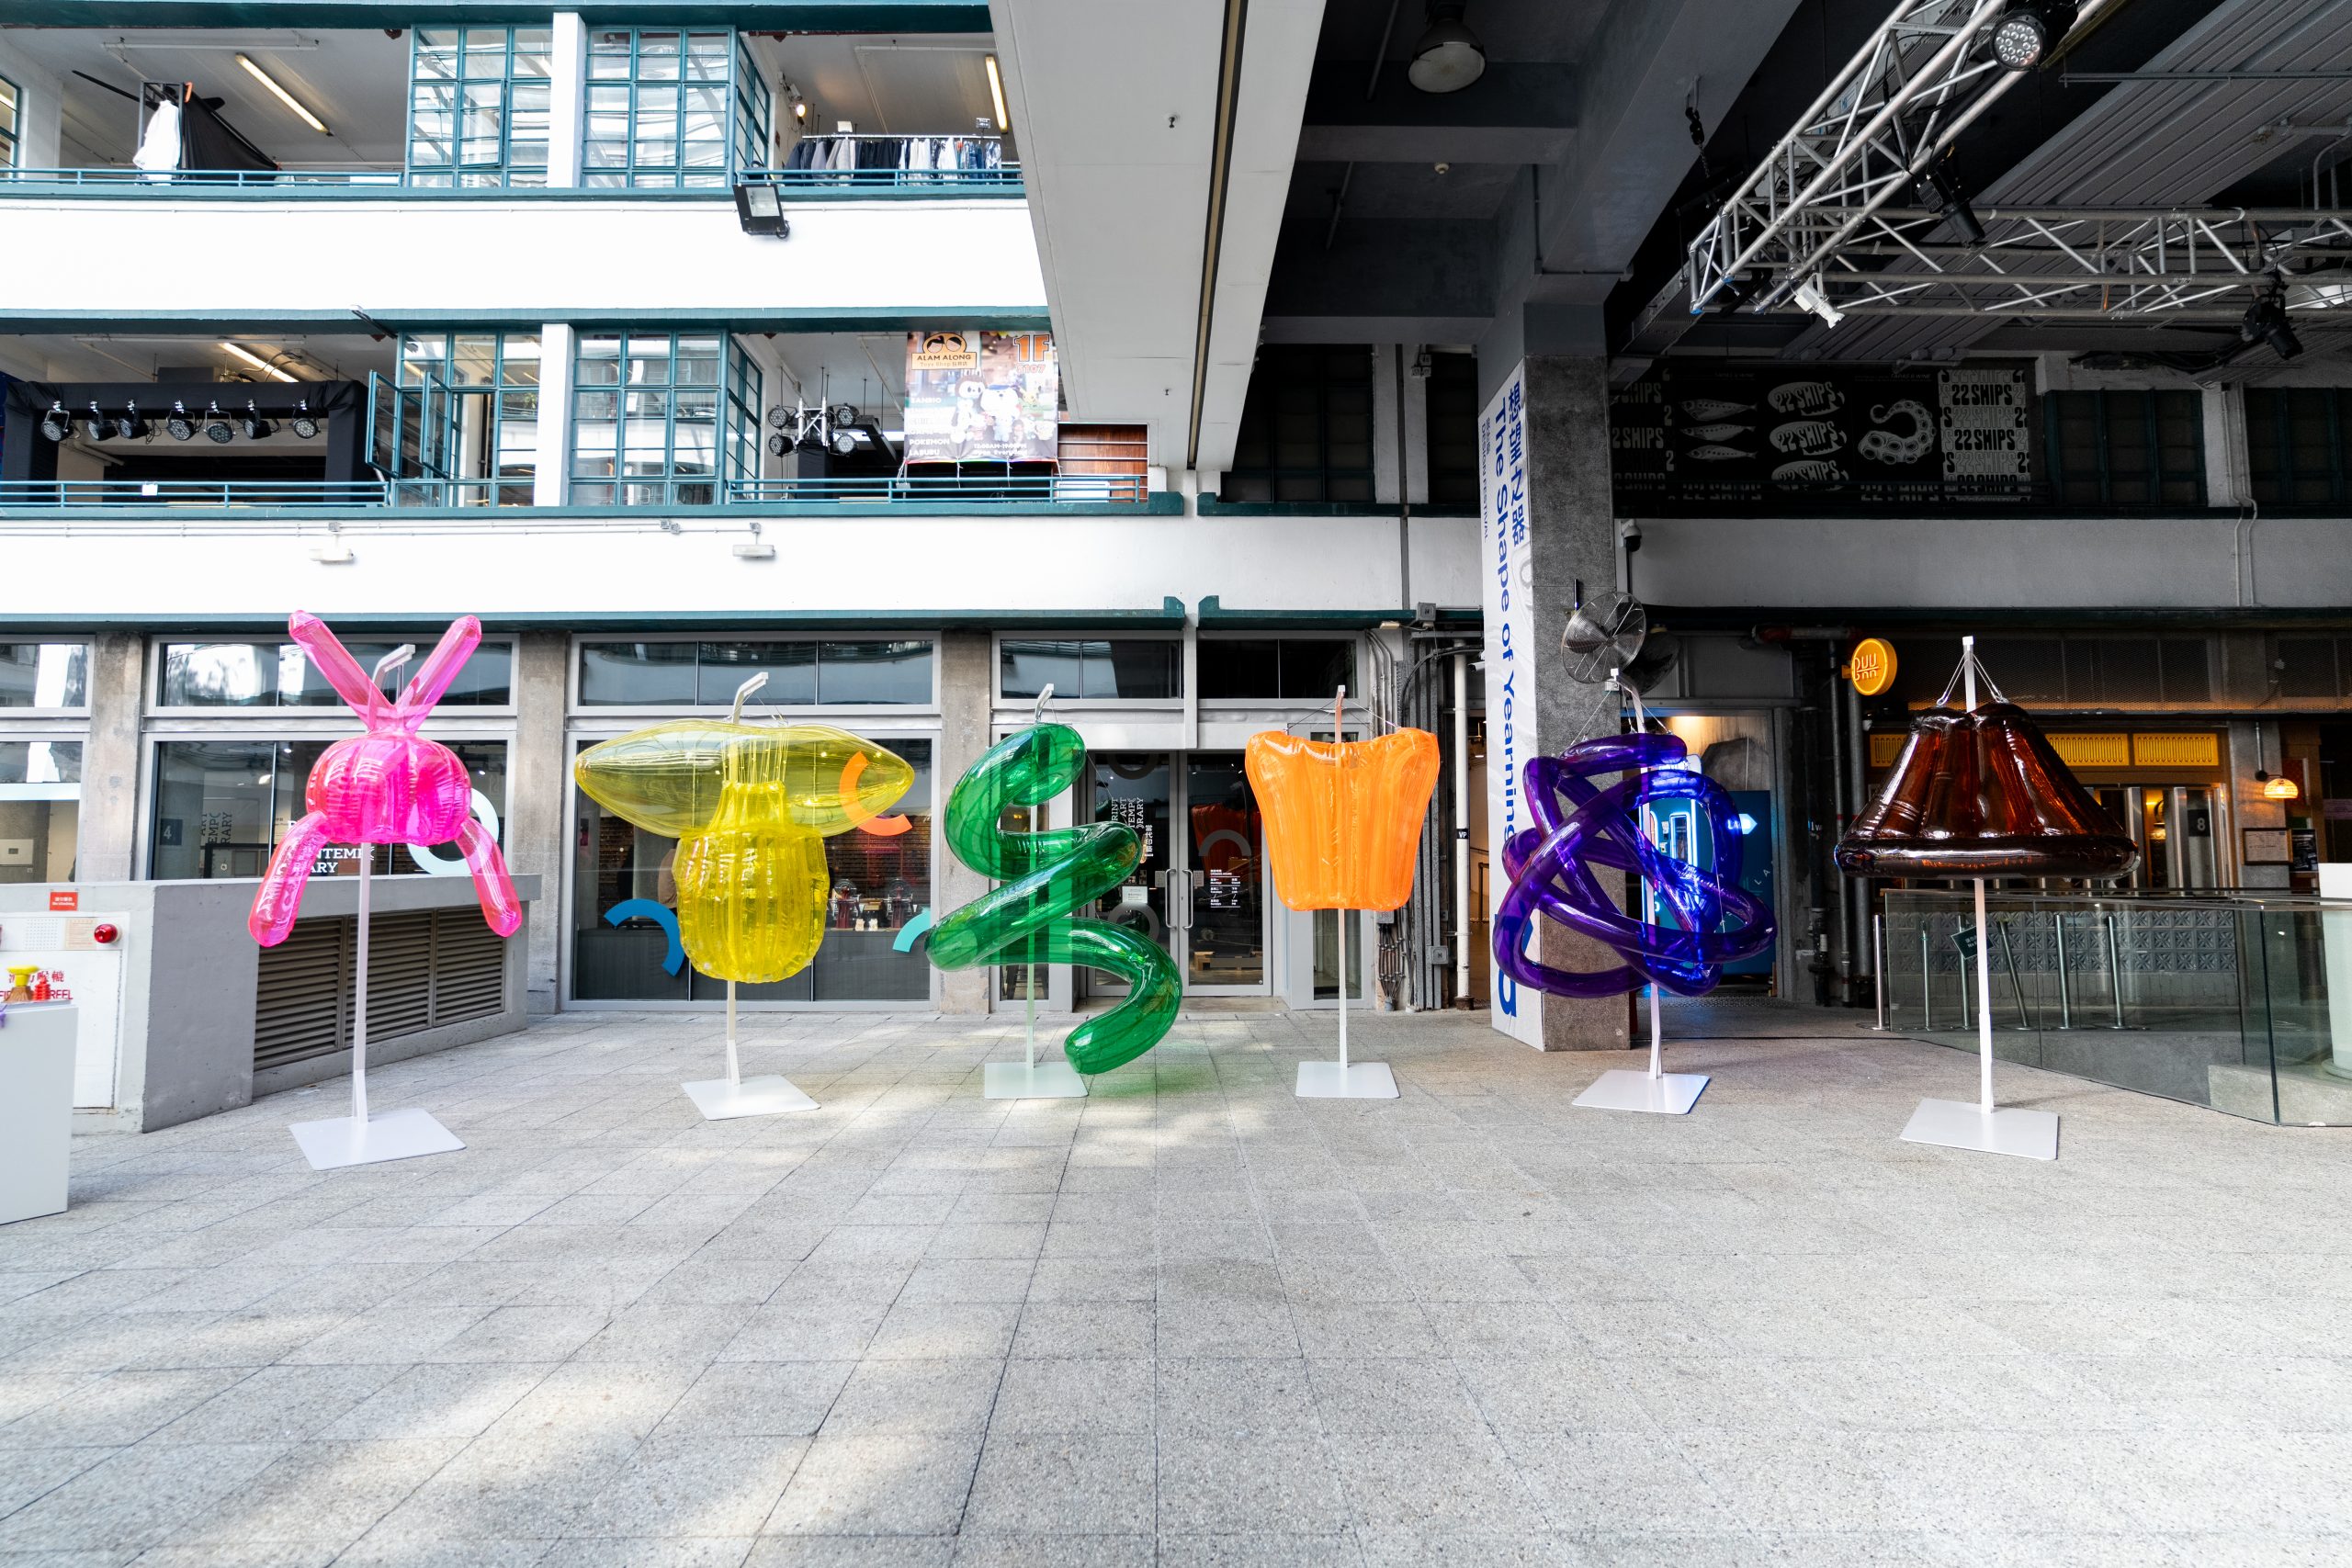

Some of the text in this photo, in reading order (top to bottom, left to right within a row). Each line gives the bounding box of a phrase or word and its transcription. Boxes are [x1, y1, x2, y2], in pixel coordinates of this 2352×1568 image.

[1014, 334, 1050, 362] 1F
[1775, 381, 1837, 413] 22 SHIPS
[1951, 384, 2012, 405] 22 SHIPS
[1623, 427, 1664, 448] SHIPS
[1778, 421, 1838, 453] 22 SHIPS
[1955, 430, 2015, 450] 22 SHIPS
[1495, 397, 1517, 840] The Shape of Yearning
[1111, 797, 1119, 821] RINT
[163, 825, 173, 840] 4
[1458, 830, 1467, 839] VP
[2197, 818, 2206, 831] 8
